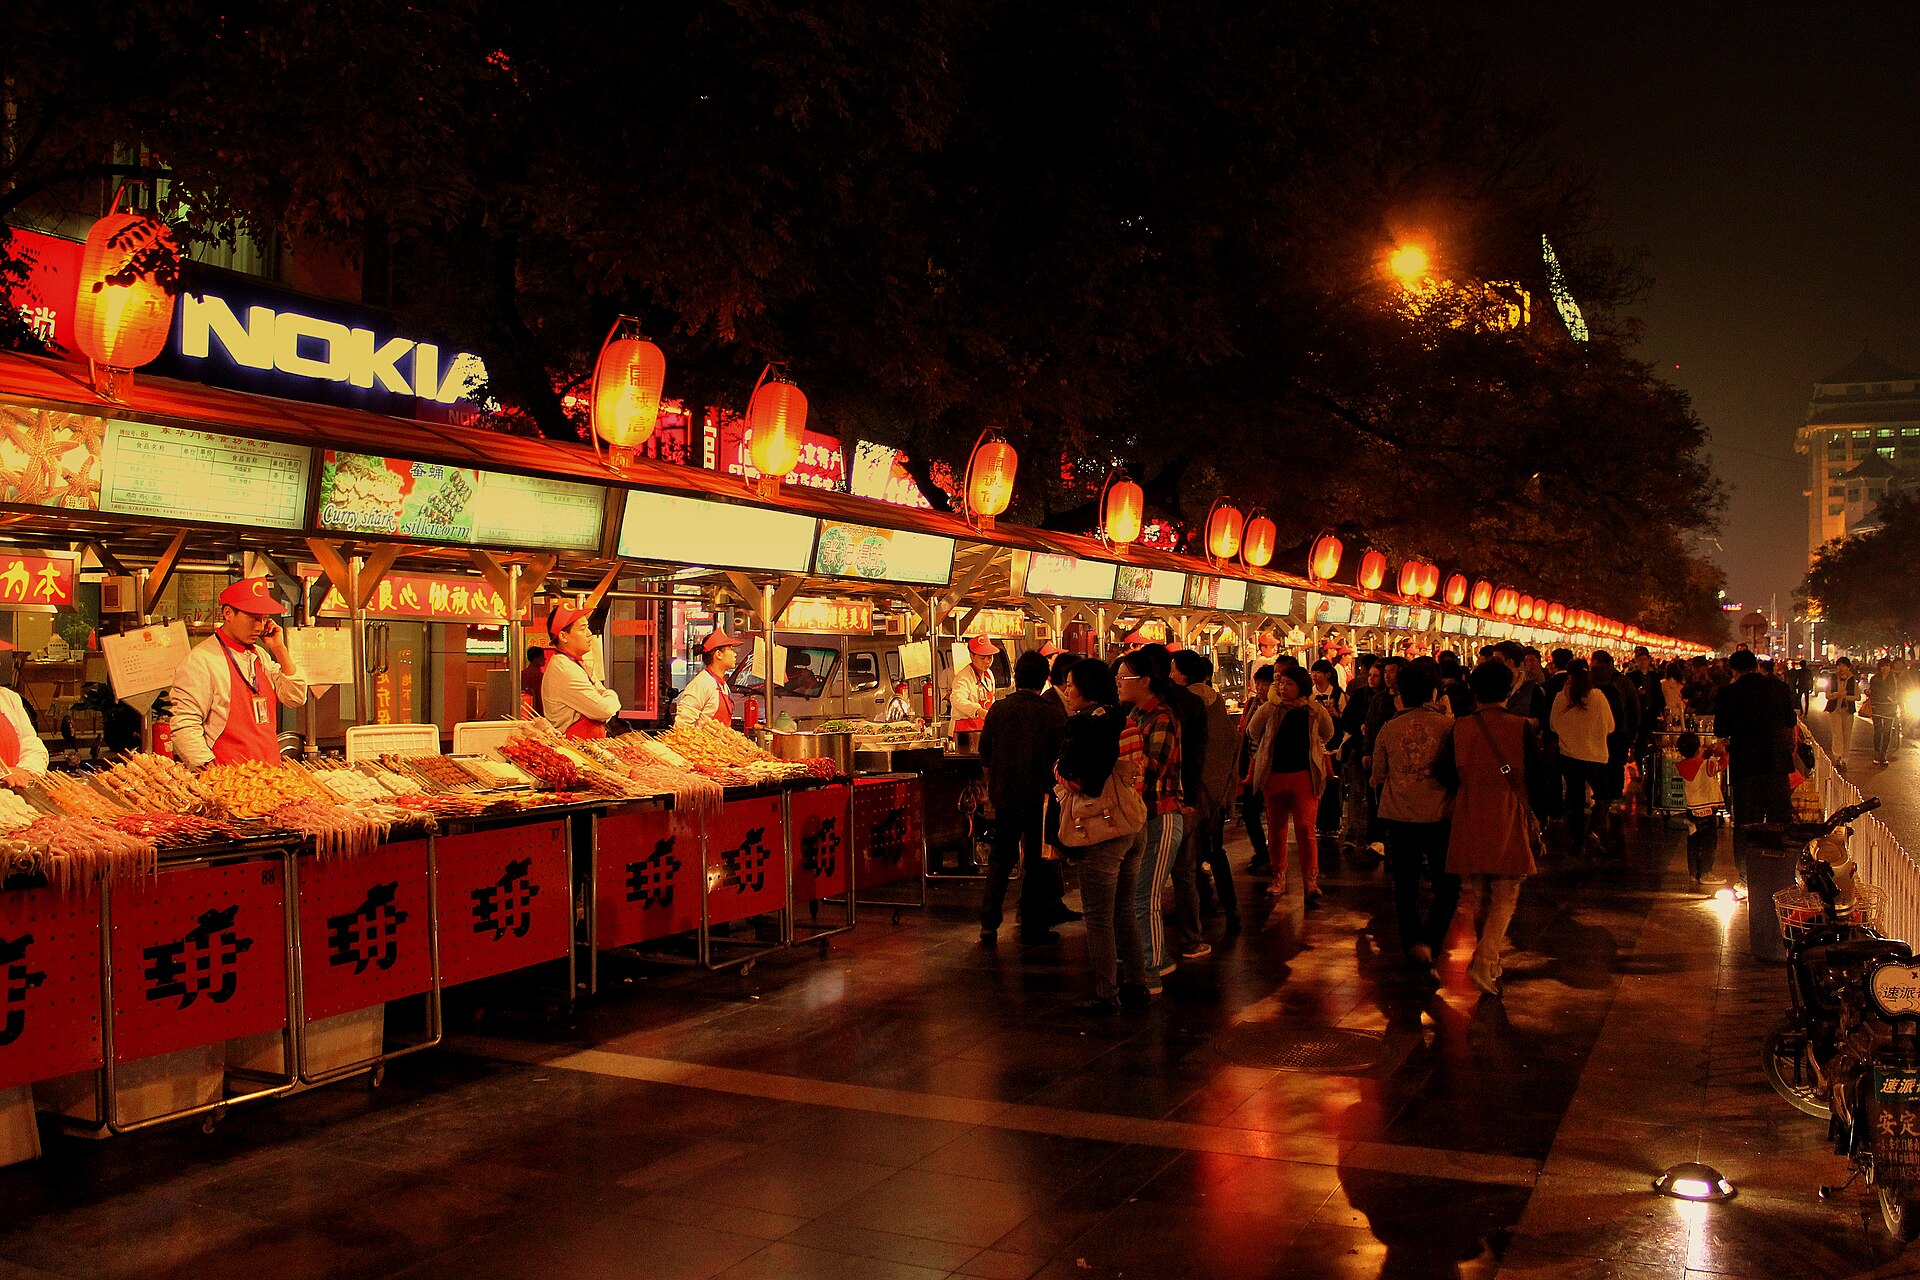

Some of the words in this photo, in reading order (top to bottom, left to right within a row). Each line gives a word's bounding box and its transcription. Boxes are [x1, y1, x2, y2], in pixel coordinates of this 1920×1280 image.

[182, 292, 501, 412] NOKIA
[411, 462, 444, 481] 蚕蛹
[323, 502, 358, 529] Curry
[361, 505, 397, 533] shark
[402, 517, 470, 538] silkworm
[429, 581, 527, 617] 做放心食
[1877, 1110, 1920, 1136] 安定
